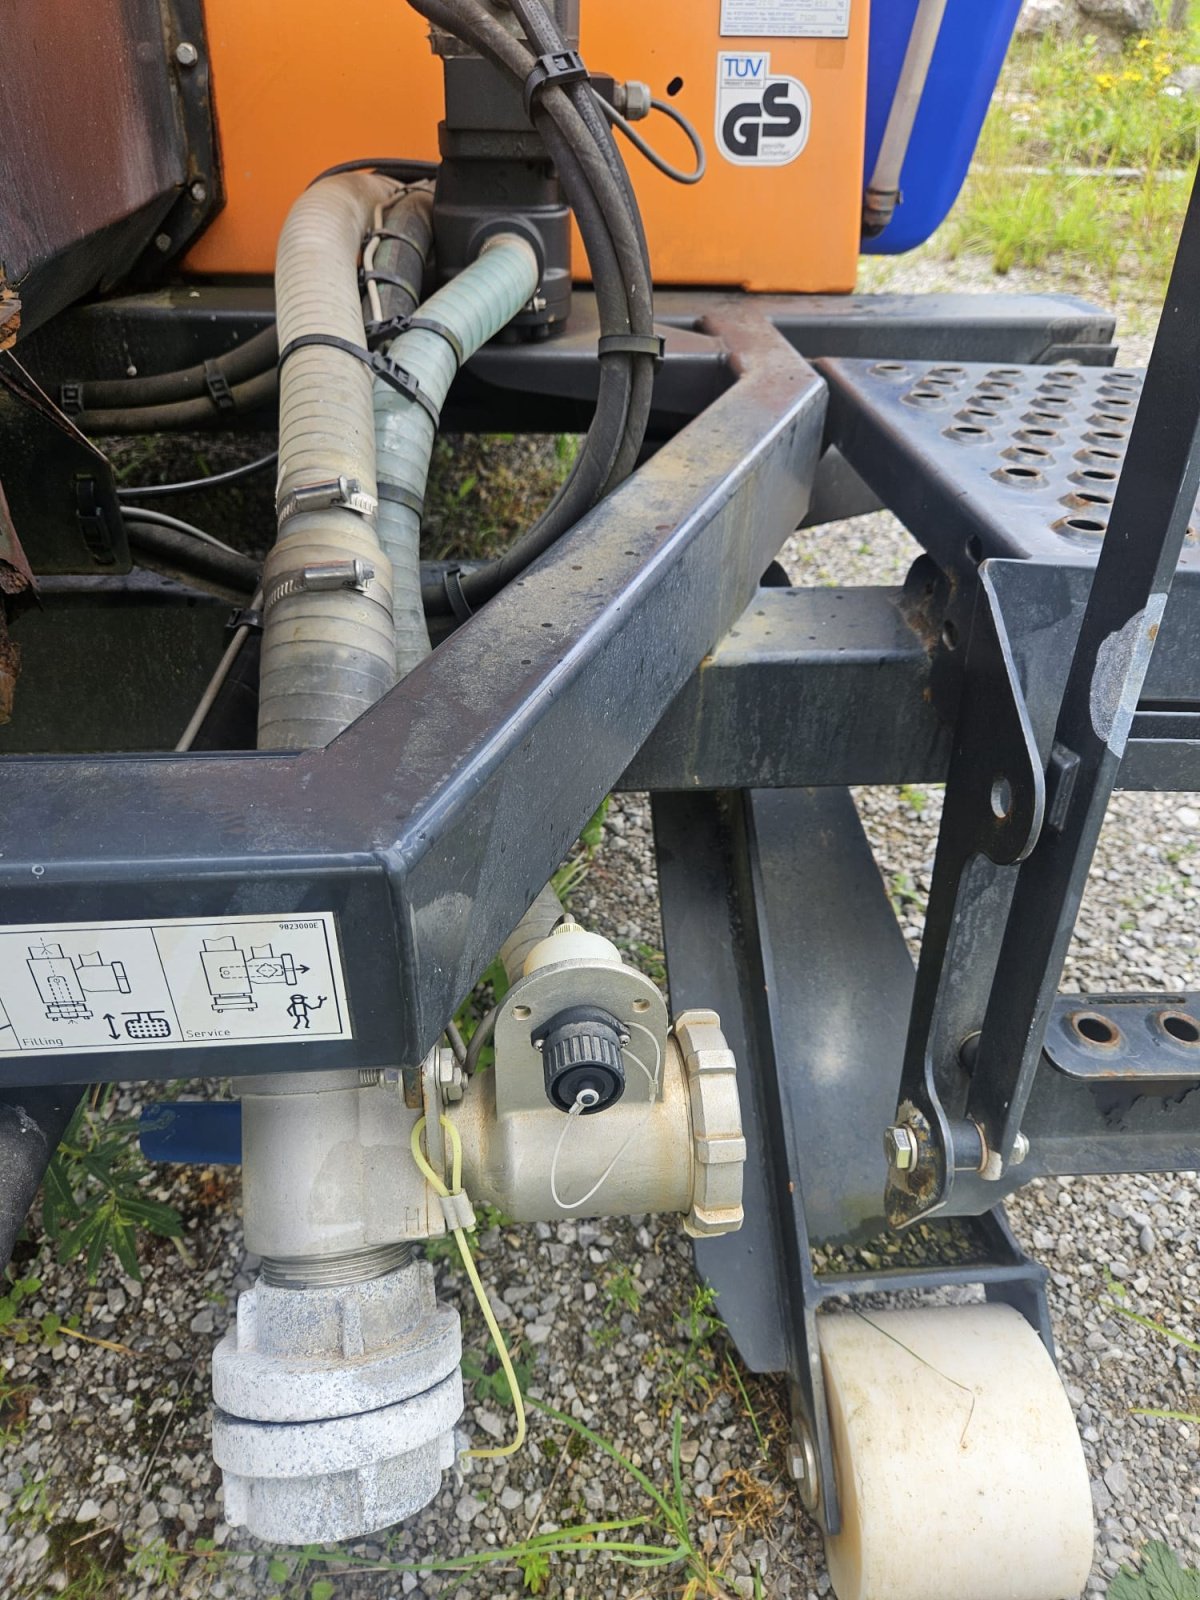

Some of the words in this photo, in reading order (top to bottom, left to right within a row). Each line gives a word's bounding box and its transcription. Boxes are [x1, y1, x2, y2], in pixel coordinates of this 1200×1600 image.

[724, 58, 762, 77] TÜV
[723, 83, 801, 156] GS
[279, 922, 318, 930] 9823000E
[186, 1029, 231, 1038] Service
[22, 1037, 64, 1047] Filling
